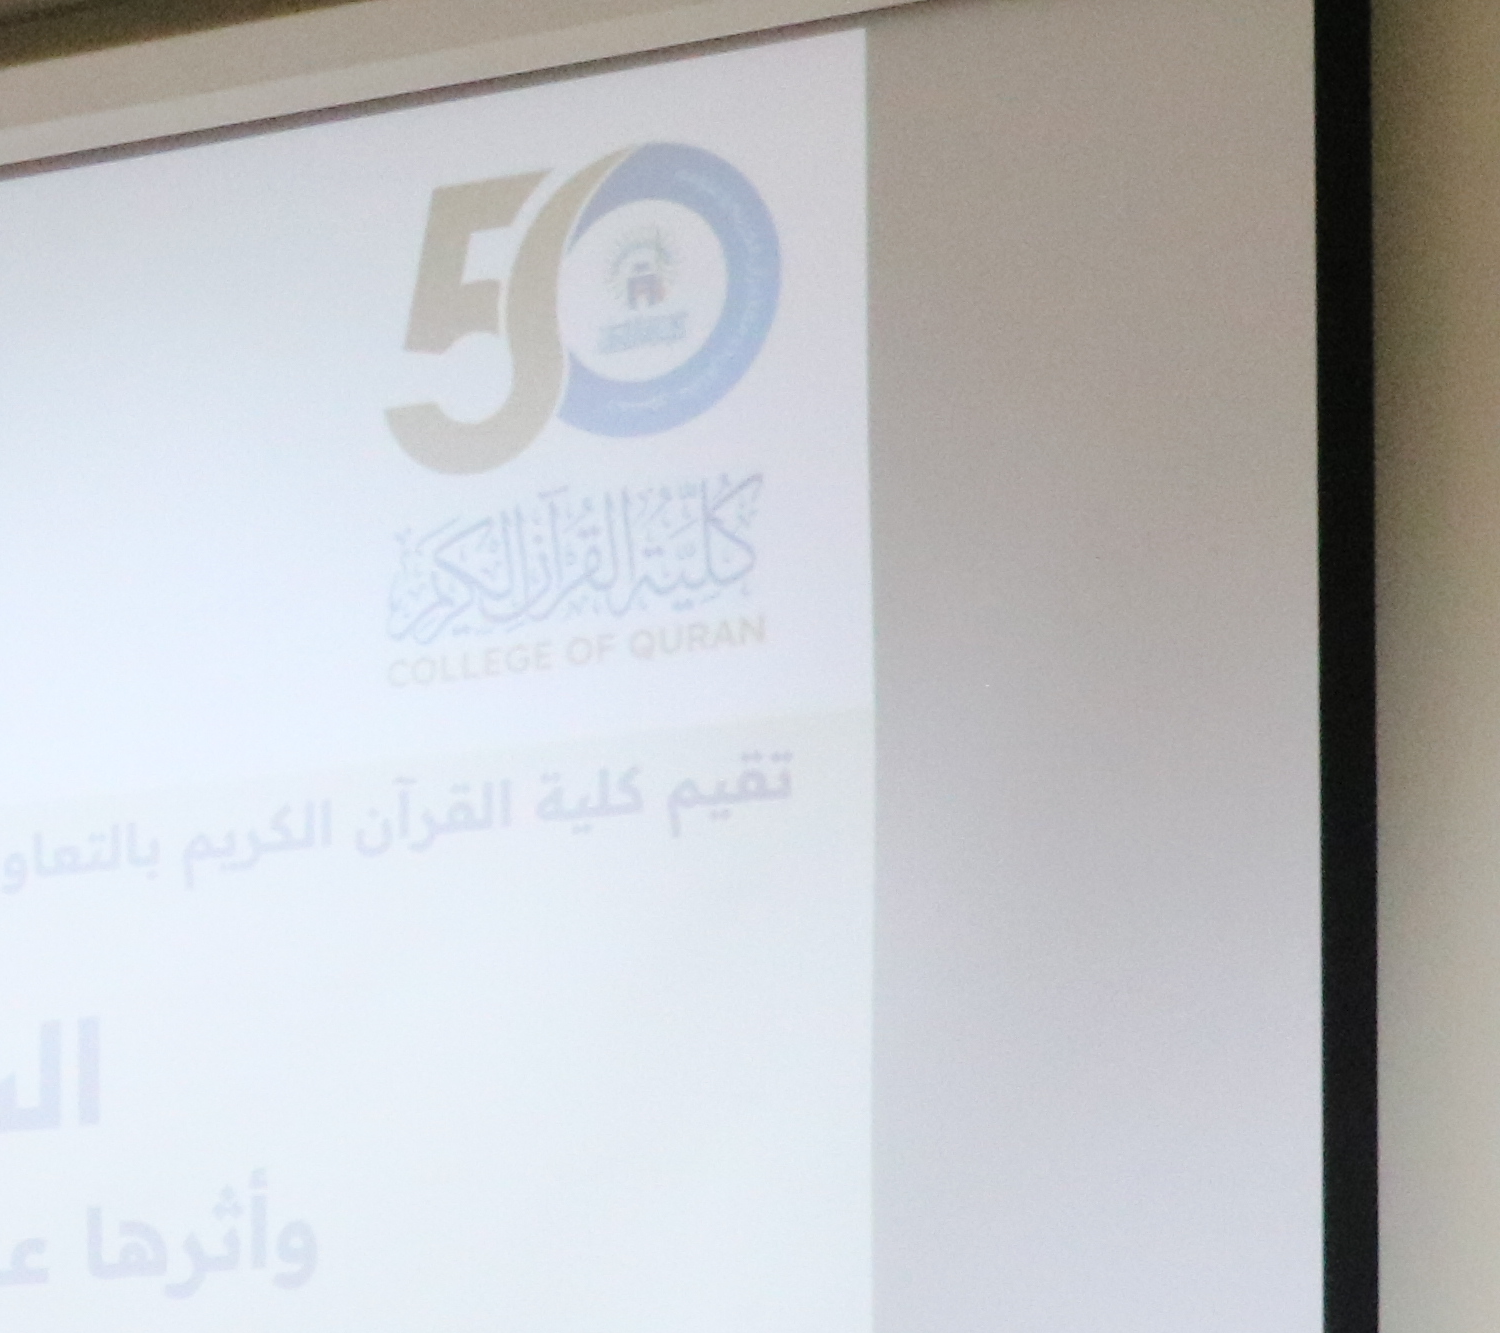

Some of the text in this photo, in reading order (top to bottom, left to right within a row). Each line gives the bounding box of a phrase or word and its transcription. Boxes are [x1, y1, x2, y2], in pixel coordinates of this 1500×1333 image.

[384, 142, 781, 475] 50
[386, 613, 767, 688] COLLEGE OF QURAN
[355, 776, 512, 856] القرآن
[534, 766, 642, 834] كلية
[667, 751, 793, 837] تقيم
[181, 800, 331, 889] الكريم
[86, 1167, 318, 1299] وأثرها
